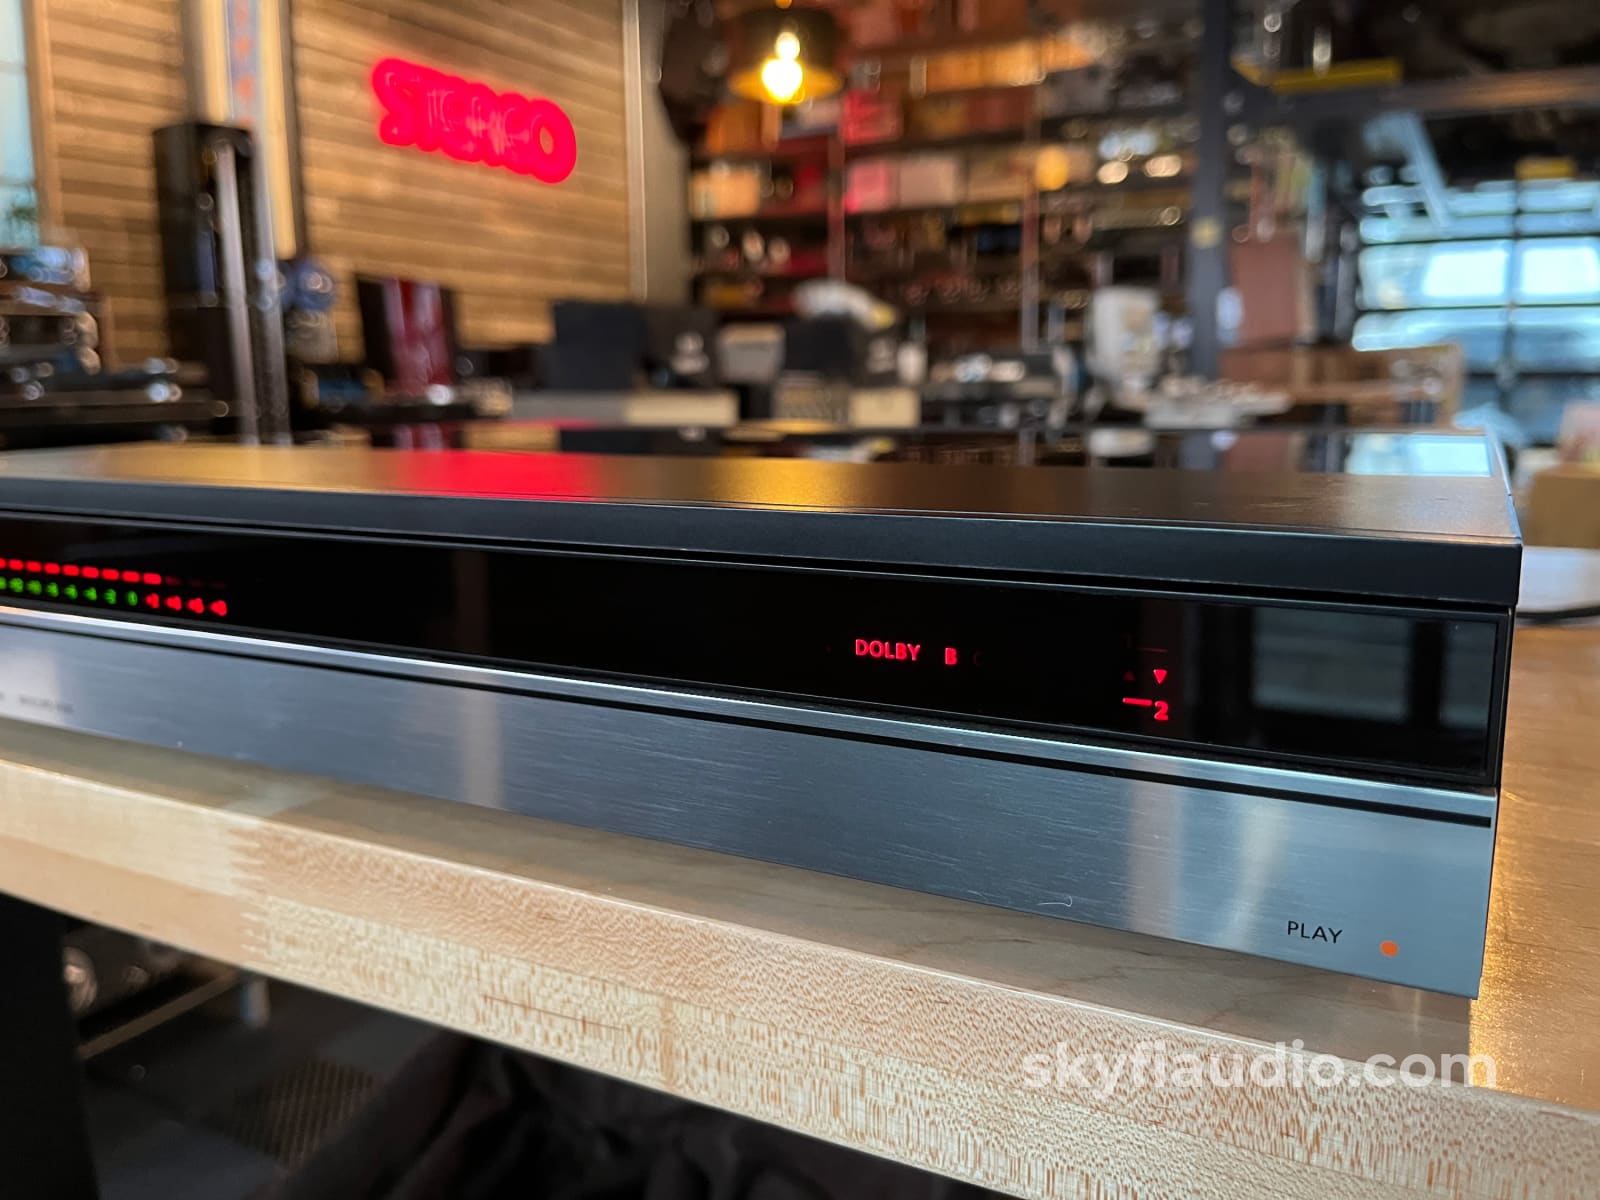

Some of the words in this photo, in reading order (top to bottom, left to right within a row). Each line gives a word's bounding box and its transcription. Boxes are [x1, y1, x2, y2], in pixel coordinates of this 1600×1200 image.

[855, 638, 921, 662] DOLBY
[944, 647, 958, 666] B
[1153, 701, 1169, 722] 2
[1287, 920, 1343, 944] PLAY
